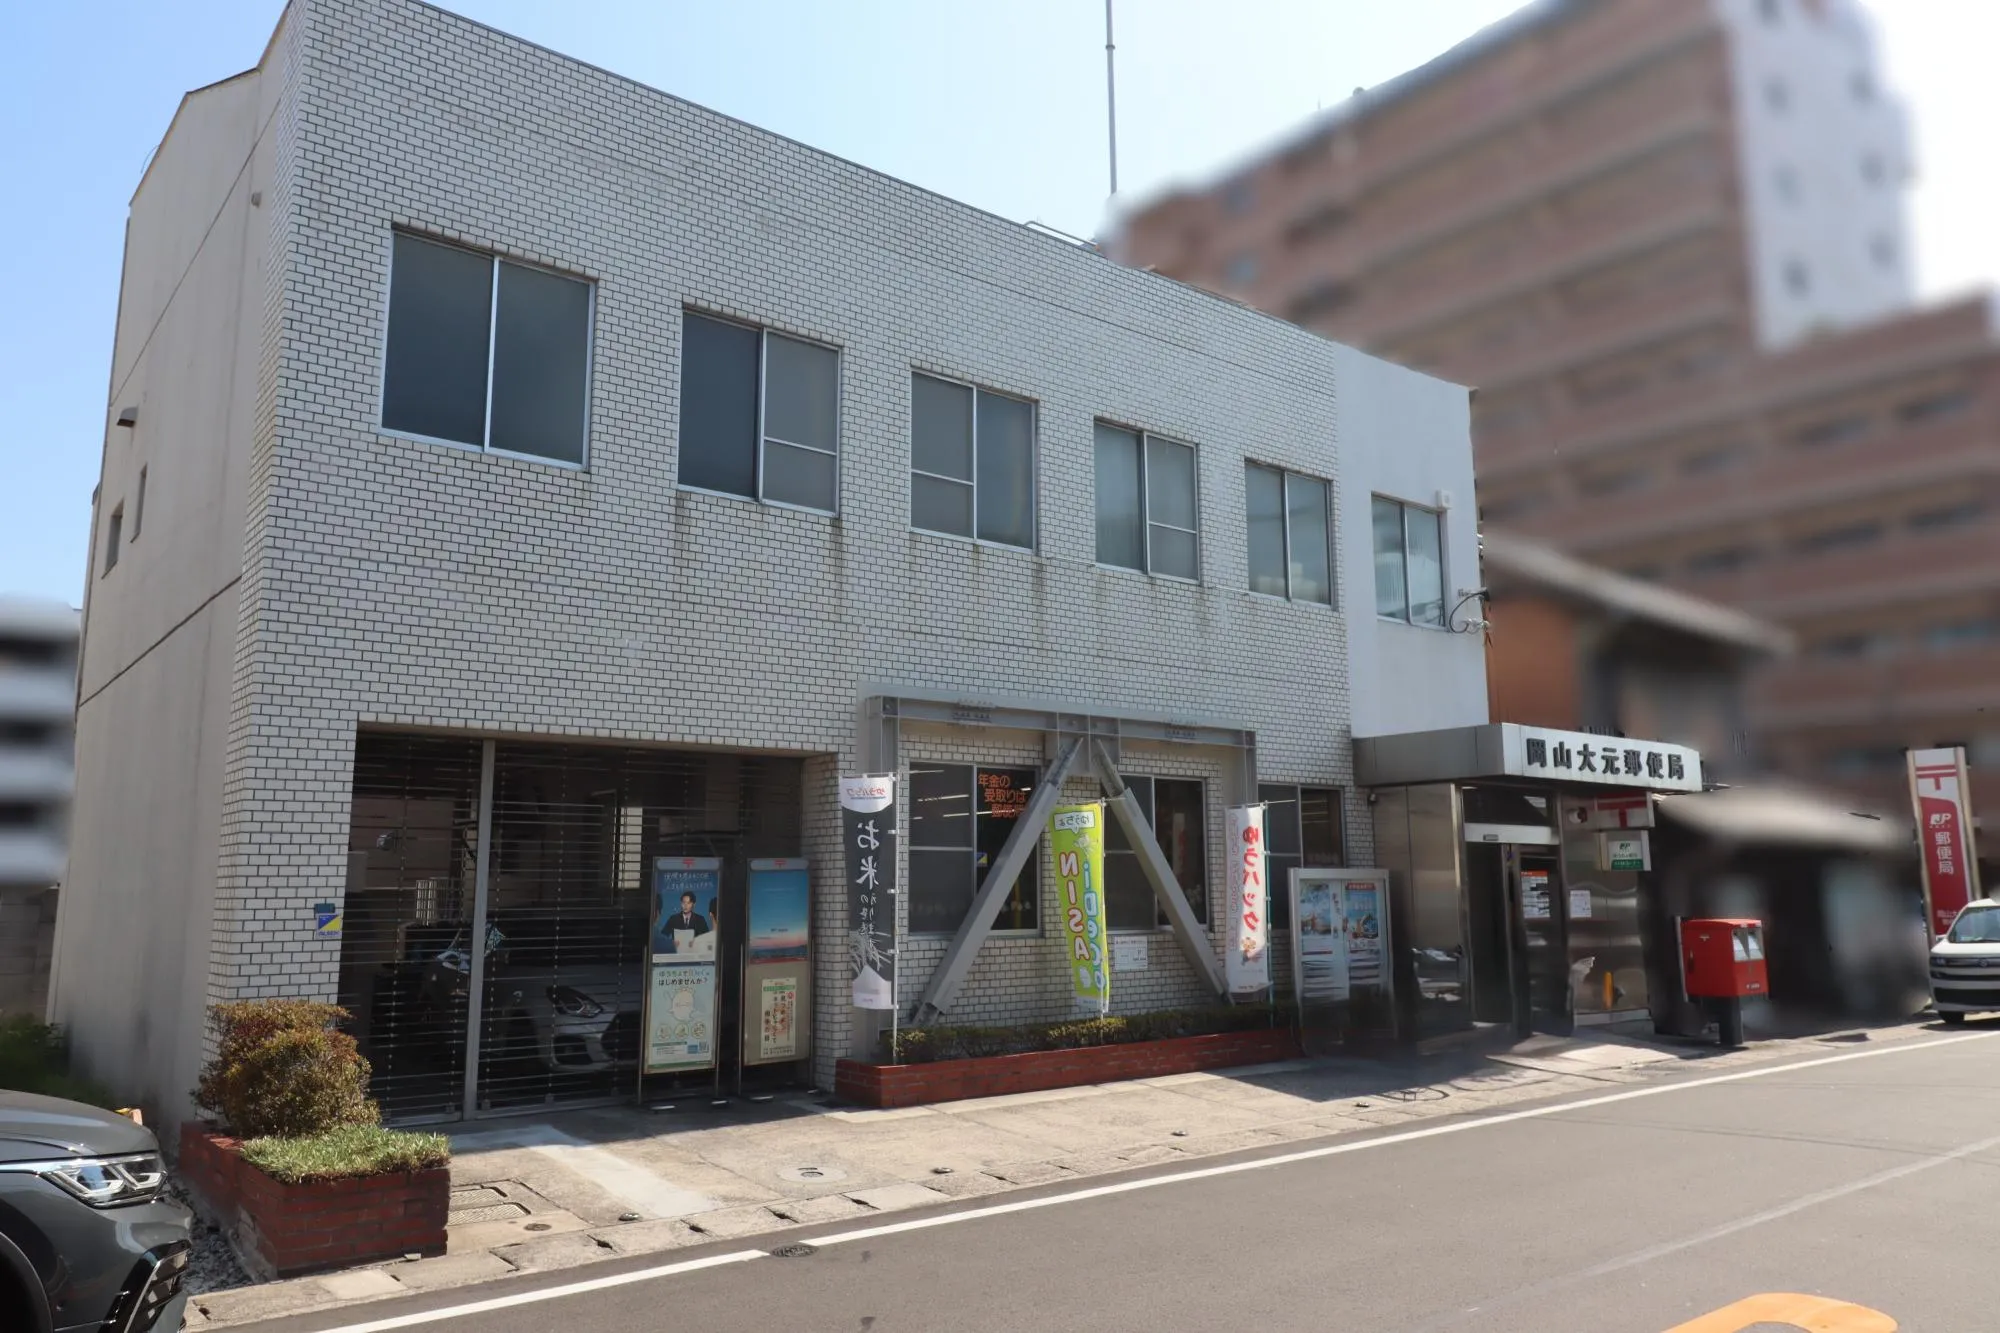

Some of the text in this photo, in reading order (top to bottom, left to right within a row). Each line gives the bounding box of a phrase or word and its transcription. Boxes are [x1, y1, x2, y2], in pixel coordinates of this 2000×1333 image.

[1526, 737, 1685, 780] 岡山大元郵便局
[978, 774, 1010, 788] 年金の
[984, 788, 1027, 803] 受取りは
[1935, 832, 1954, 875] 郵便局
